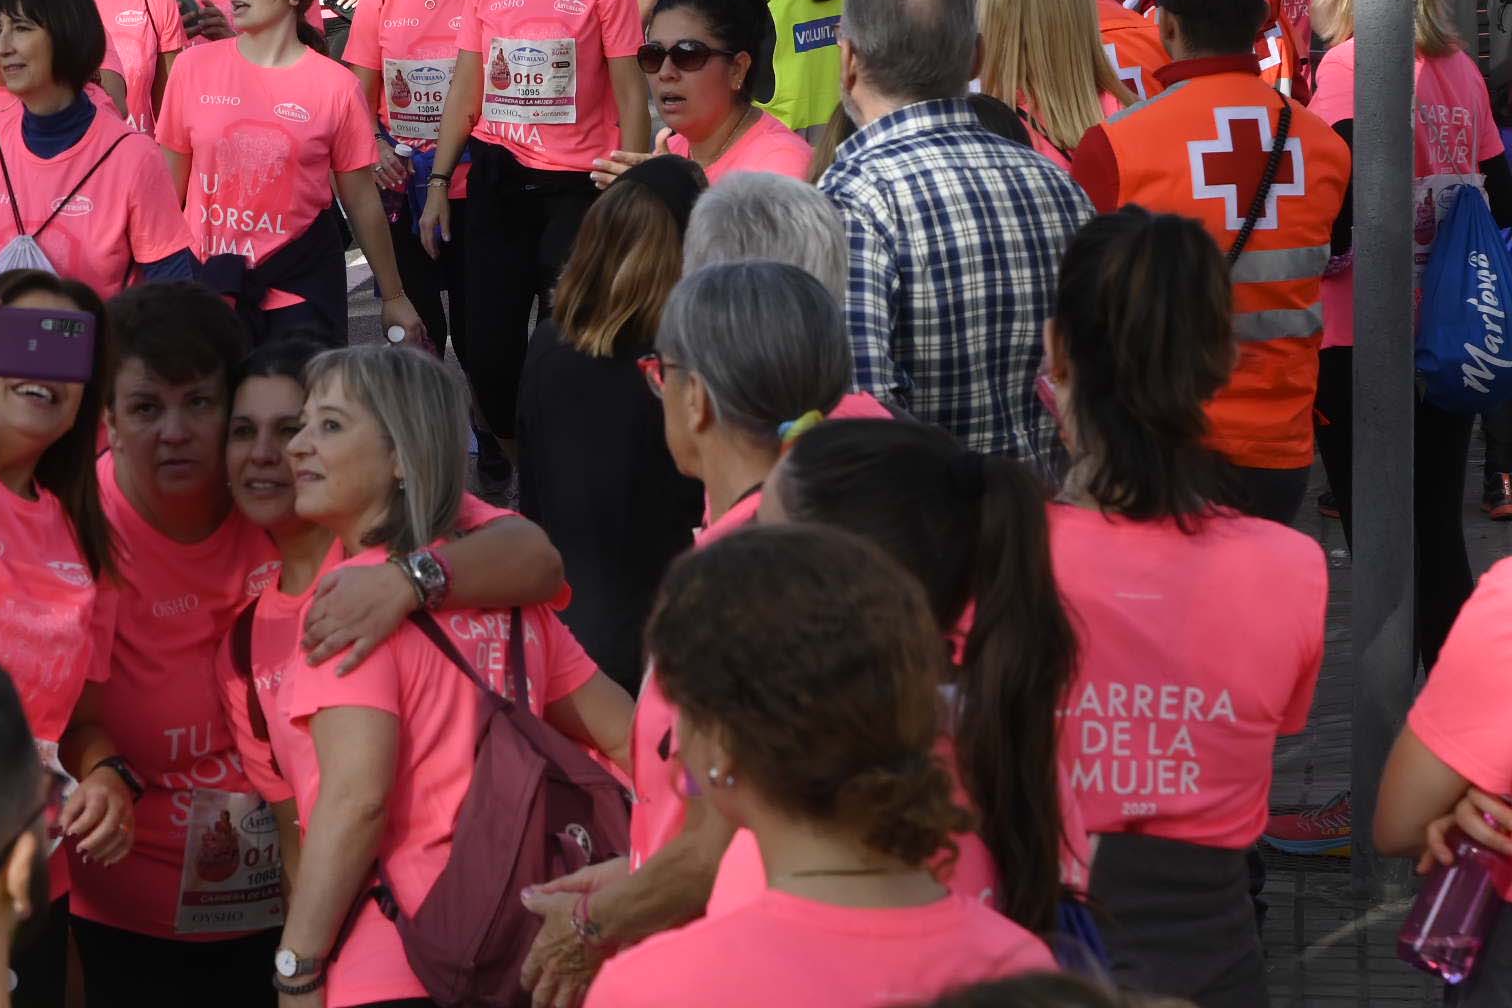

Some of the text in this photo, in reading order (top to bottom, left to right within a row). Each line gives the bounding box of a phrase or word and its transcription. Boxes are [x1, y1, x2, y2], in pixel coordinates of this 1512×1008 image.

[383, 17, 420, 29] OYSHO
[511, 53, 546, 63] ASTURIANA
[513, 72, 544, 85] 016
[413, 91, 443, 103] 016
[518, 88, 540, 96] 13095
[200, 94, 241, 106] OYSHO
[417, 105, 440, 113] 13094
[491, 107, 518, 117] OYSHO
[200, 235, 256, 263] UMA
[1055, 681, 1237, 724] ARRERA
[162, 720, 213, 762] TU
[1082, 720, 1197, 758] DE LA
[1070, 758, 1201, 795] MUJER
[1121, 801, 1158, 816] 2023
[243, 843, 280, 868] 01
